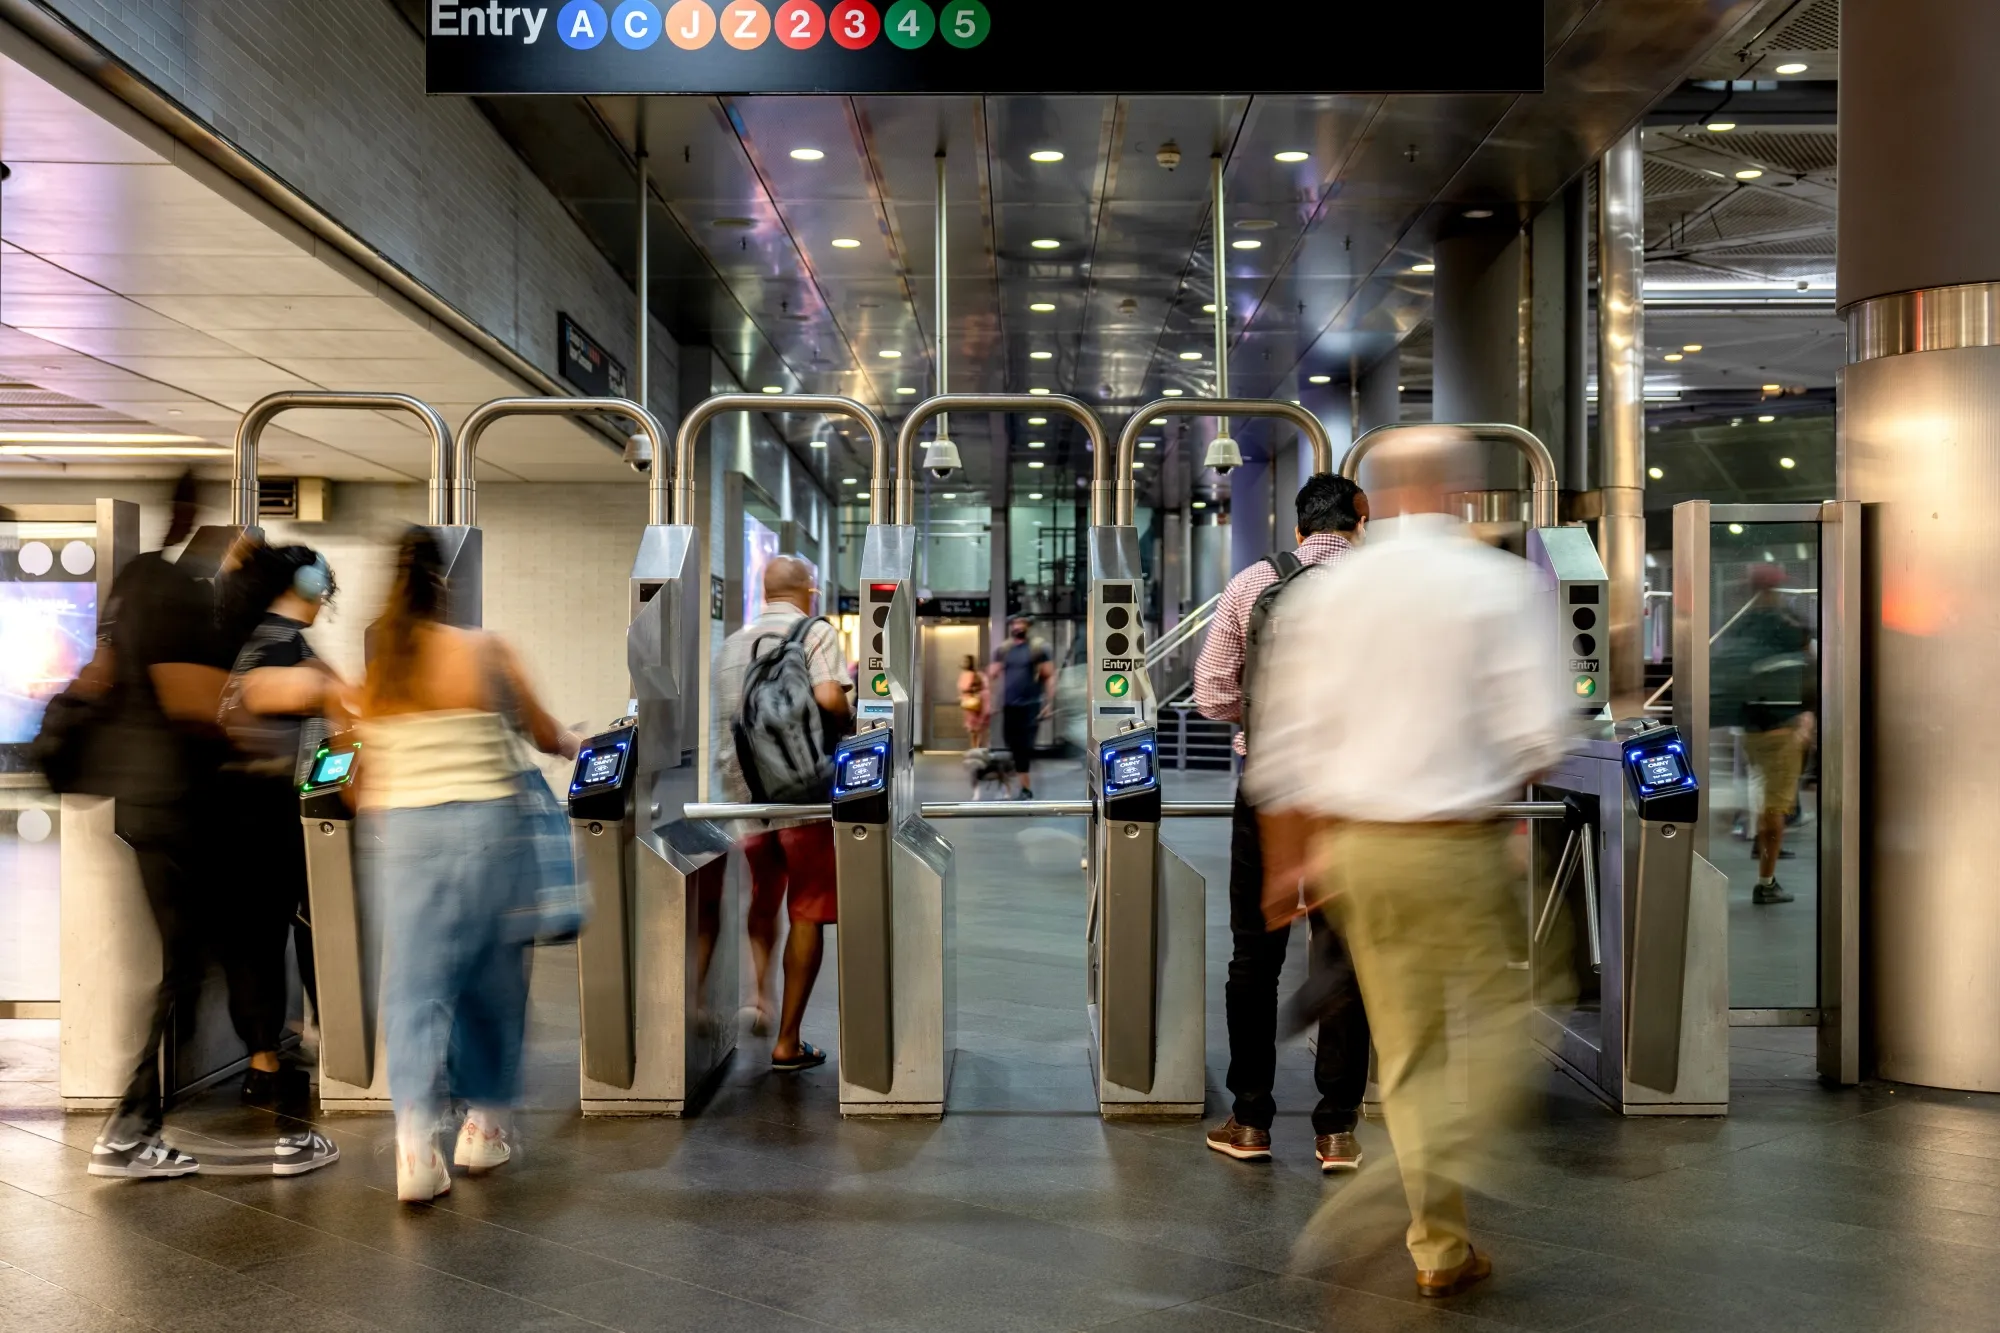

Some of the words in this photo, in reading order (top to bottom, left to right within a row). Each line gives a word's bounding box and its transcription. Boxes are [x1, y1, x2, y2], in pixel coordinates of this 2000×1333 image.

[431, 0, 549, 45] Entry
[569, 9, 595, 38] A
[624, 10, 649, 39] C
[680, 10, 700, 39] J
[733, 10, 757, 38] Z
[789, 9, 812, 38] 2
[844, 9, 866, 39] 3
[897, 9, 920, 37] 4
[954, 10, 976, 38] 5
[1103, 659, 1131, 671] Entry
[1570, 660, 1598, 672] Entry
[593, 758, 614, 766] OMNY
[852, 761, 873, 769] OMNY
[1120, 759, 1141, 768] OMNY
[1647, 760, 1669, 768] OMNY
